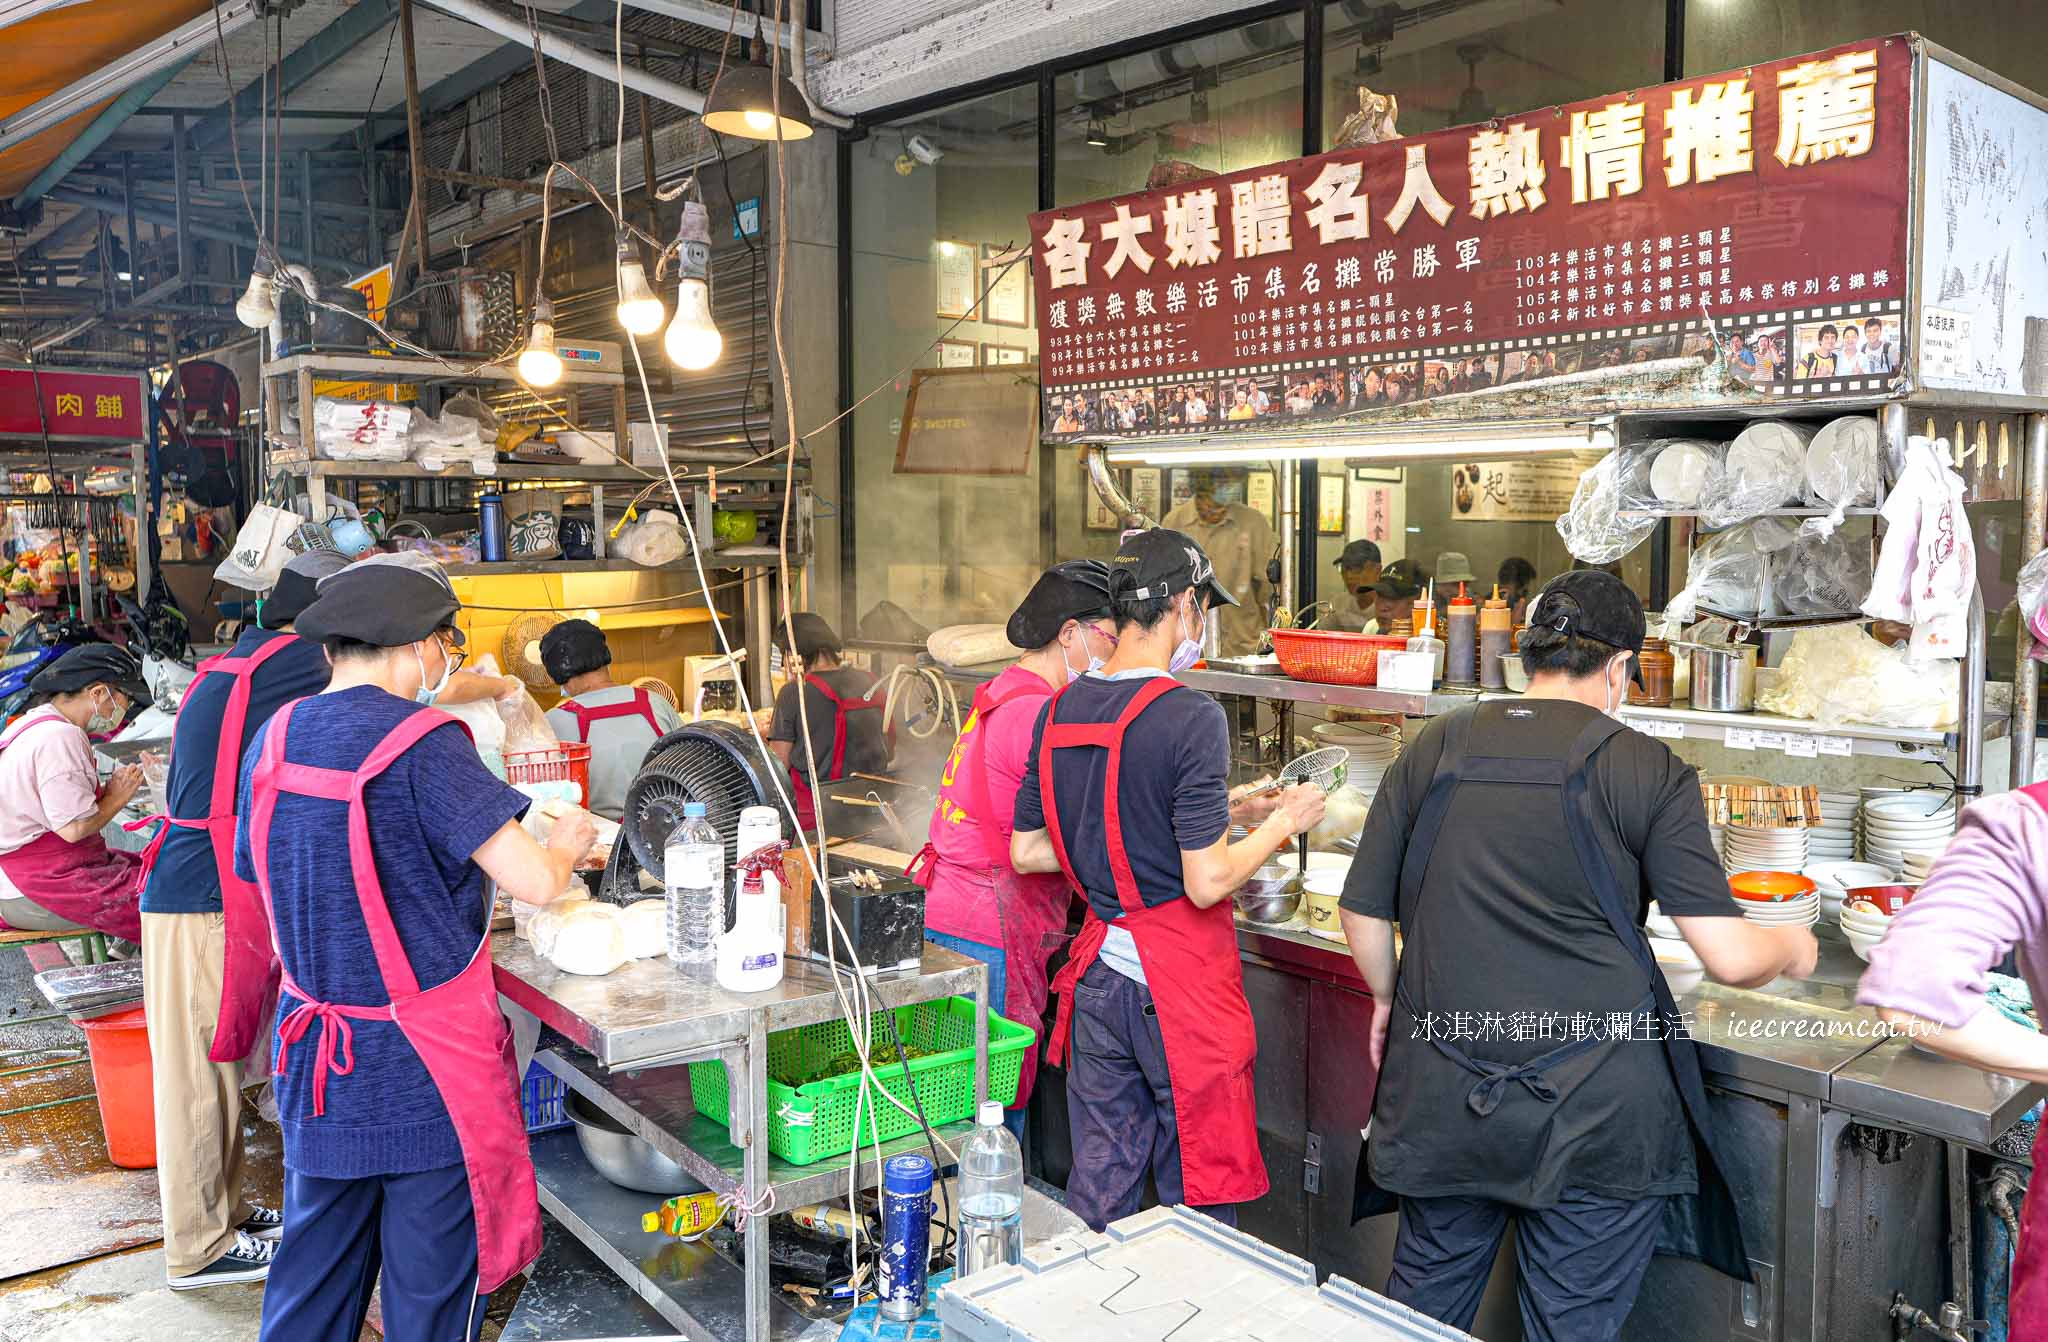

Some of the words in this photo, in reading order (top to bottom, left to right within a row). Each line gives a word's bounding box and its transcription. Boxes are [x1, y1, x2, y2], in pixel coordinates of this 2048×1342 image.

[1041, 48, 1878, 290] 各大媒體名人熱情推薦
[1516, 227, 1732, 271] 103年樂活市集名攤三顆星
[1516, 247, 1732, 289] 104年樂活市集名攤三顆星
[1050, 236, 1481, 329] 獲獎無數樂活市集名攤常勝軍
[1516, 268, 1732, 308] 105年樂活市集名攤三顆星
